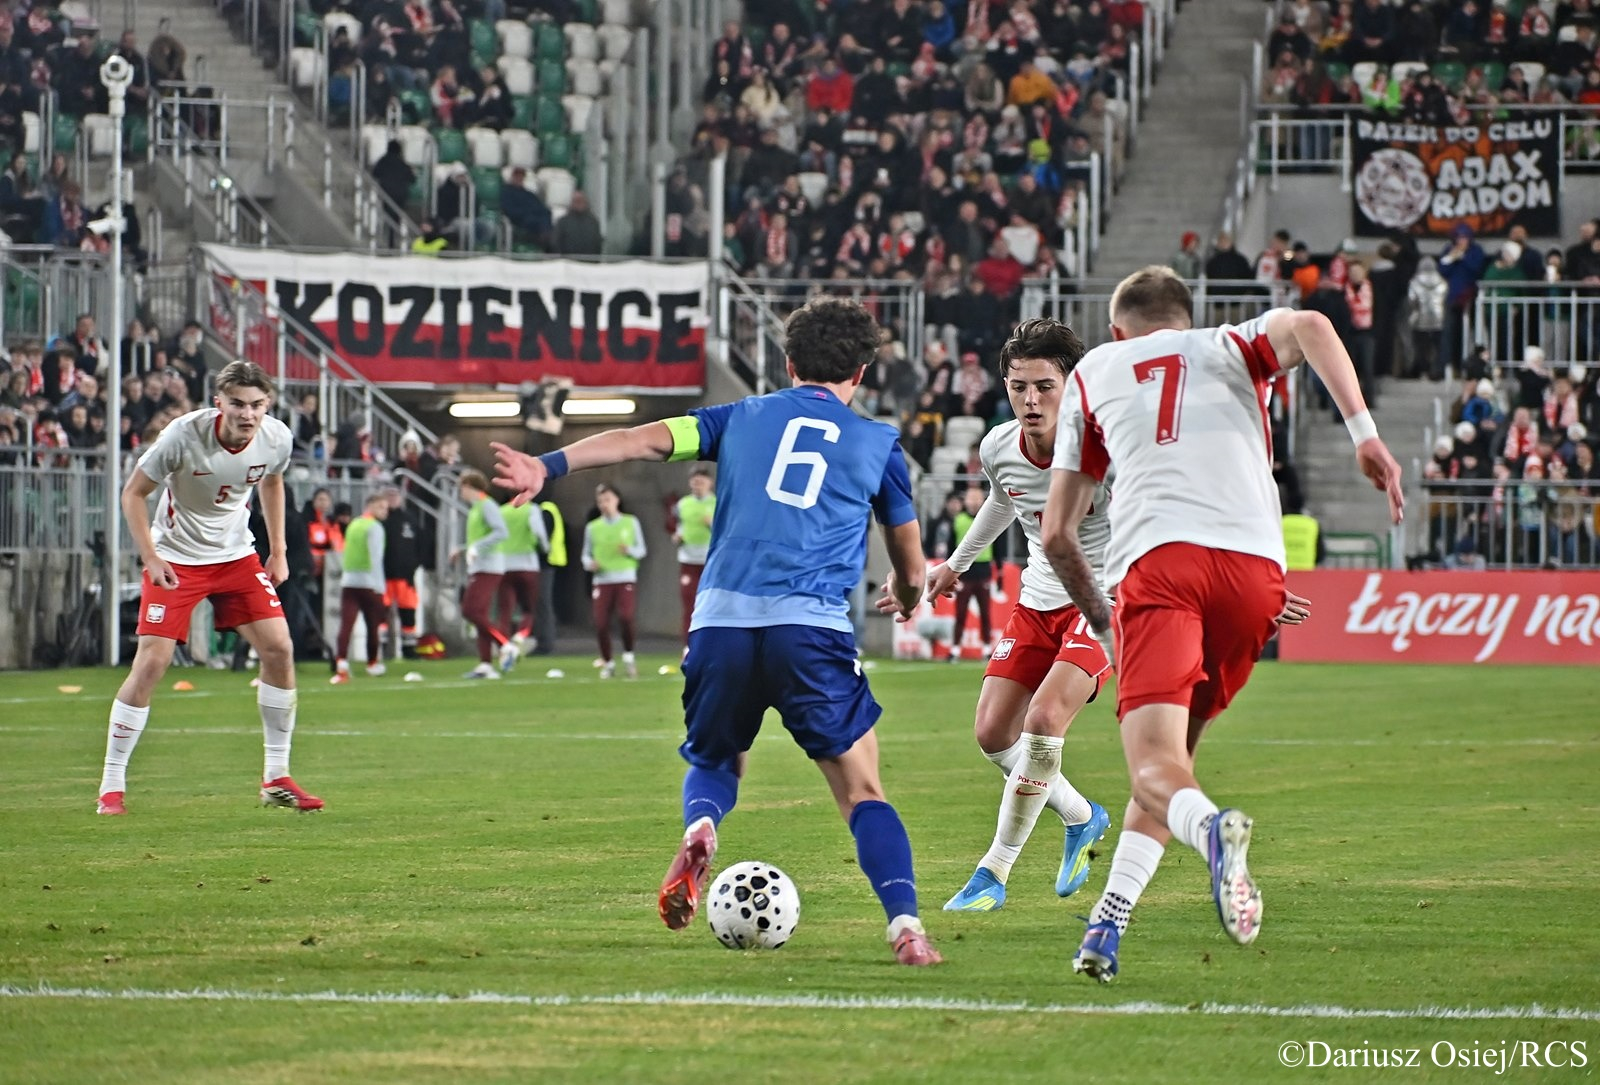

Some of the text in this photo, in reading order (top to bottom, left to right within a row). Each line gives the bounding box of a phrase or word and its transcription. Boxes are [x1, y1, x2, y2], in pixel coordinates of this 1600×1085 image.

[1488, 118, 1551, 141] CELU
[1437, 150, 1542, 190] AJAX
[1432, 179, 1551, 219] RADOM
[274, 278, 700, 363] KOZIENICE
[1133, 353, 1187, 446] 7
[765, 416, 841, 510] 6
[214, 485, 232, 504] 5
[255, 572, 278, 596] 5
[1345, 573, 1519, 663] Łączy
